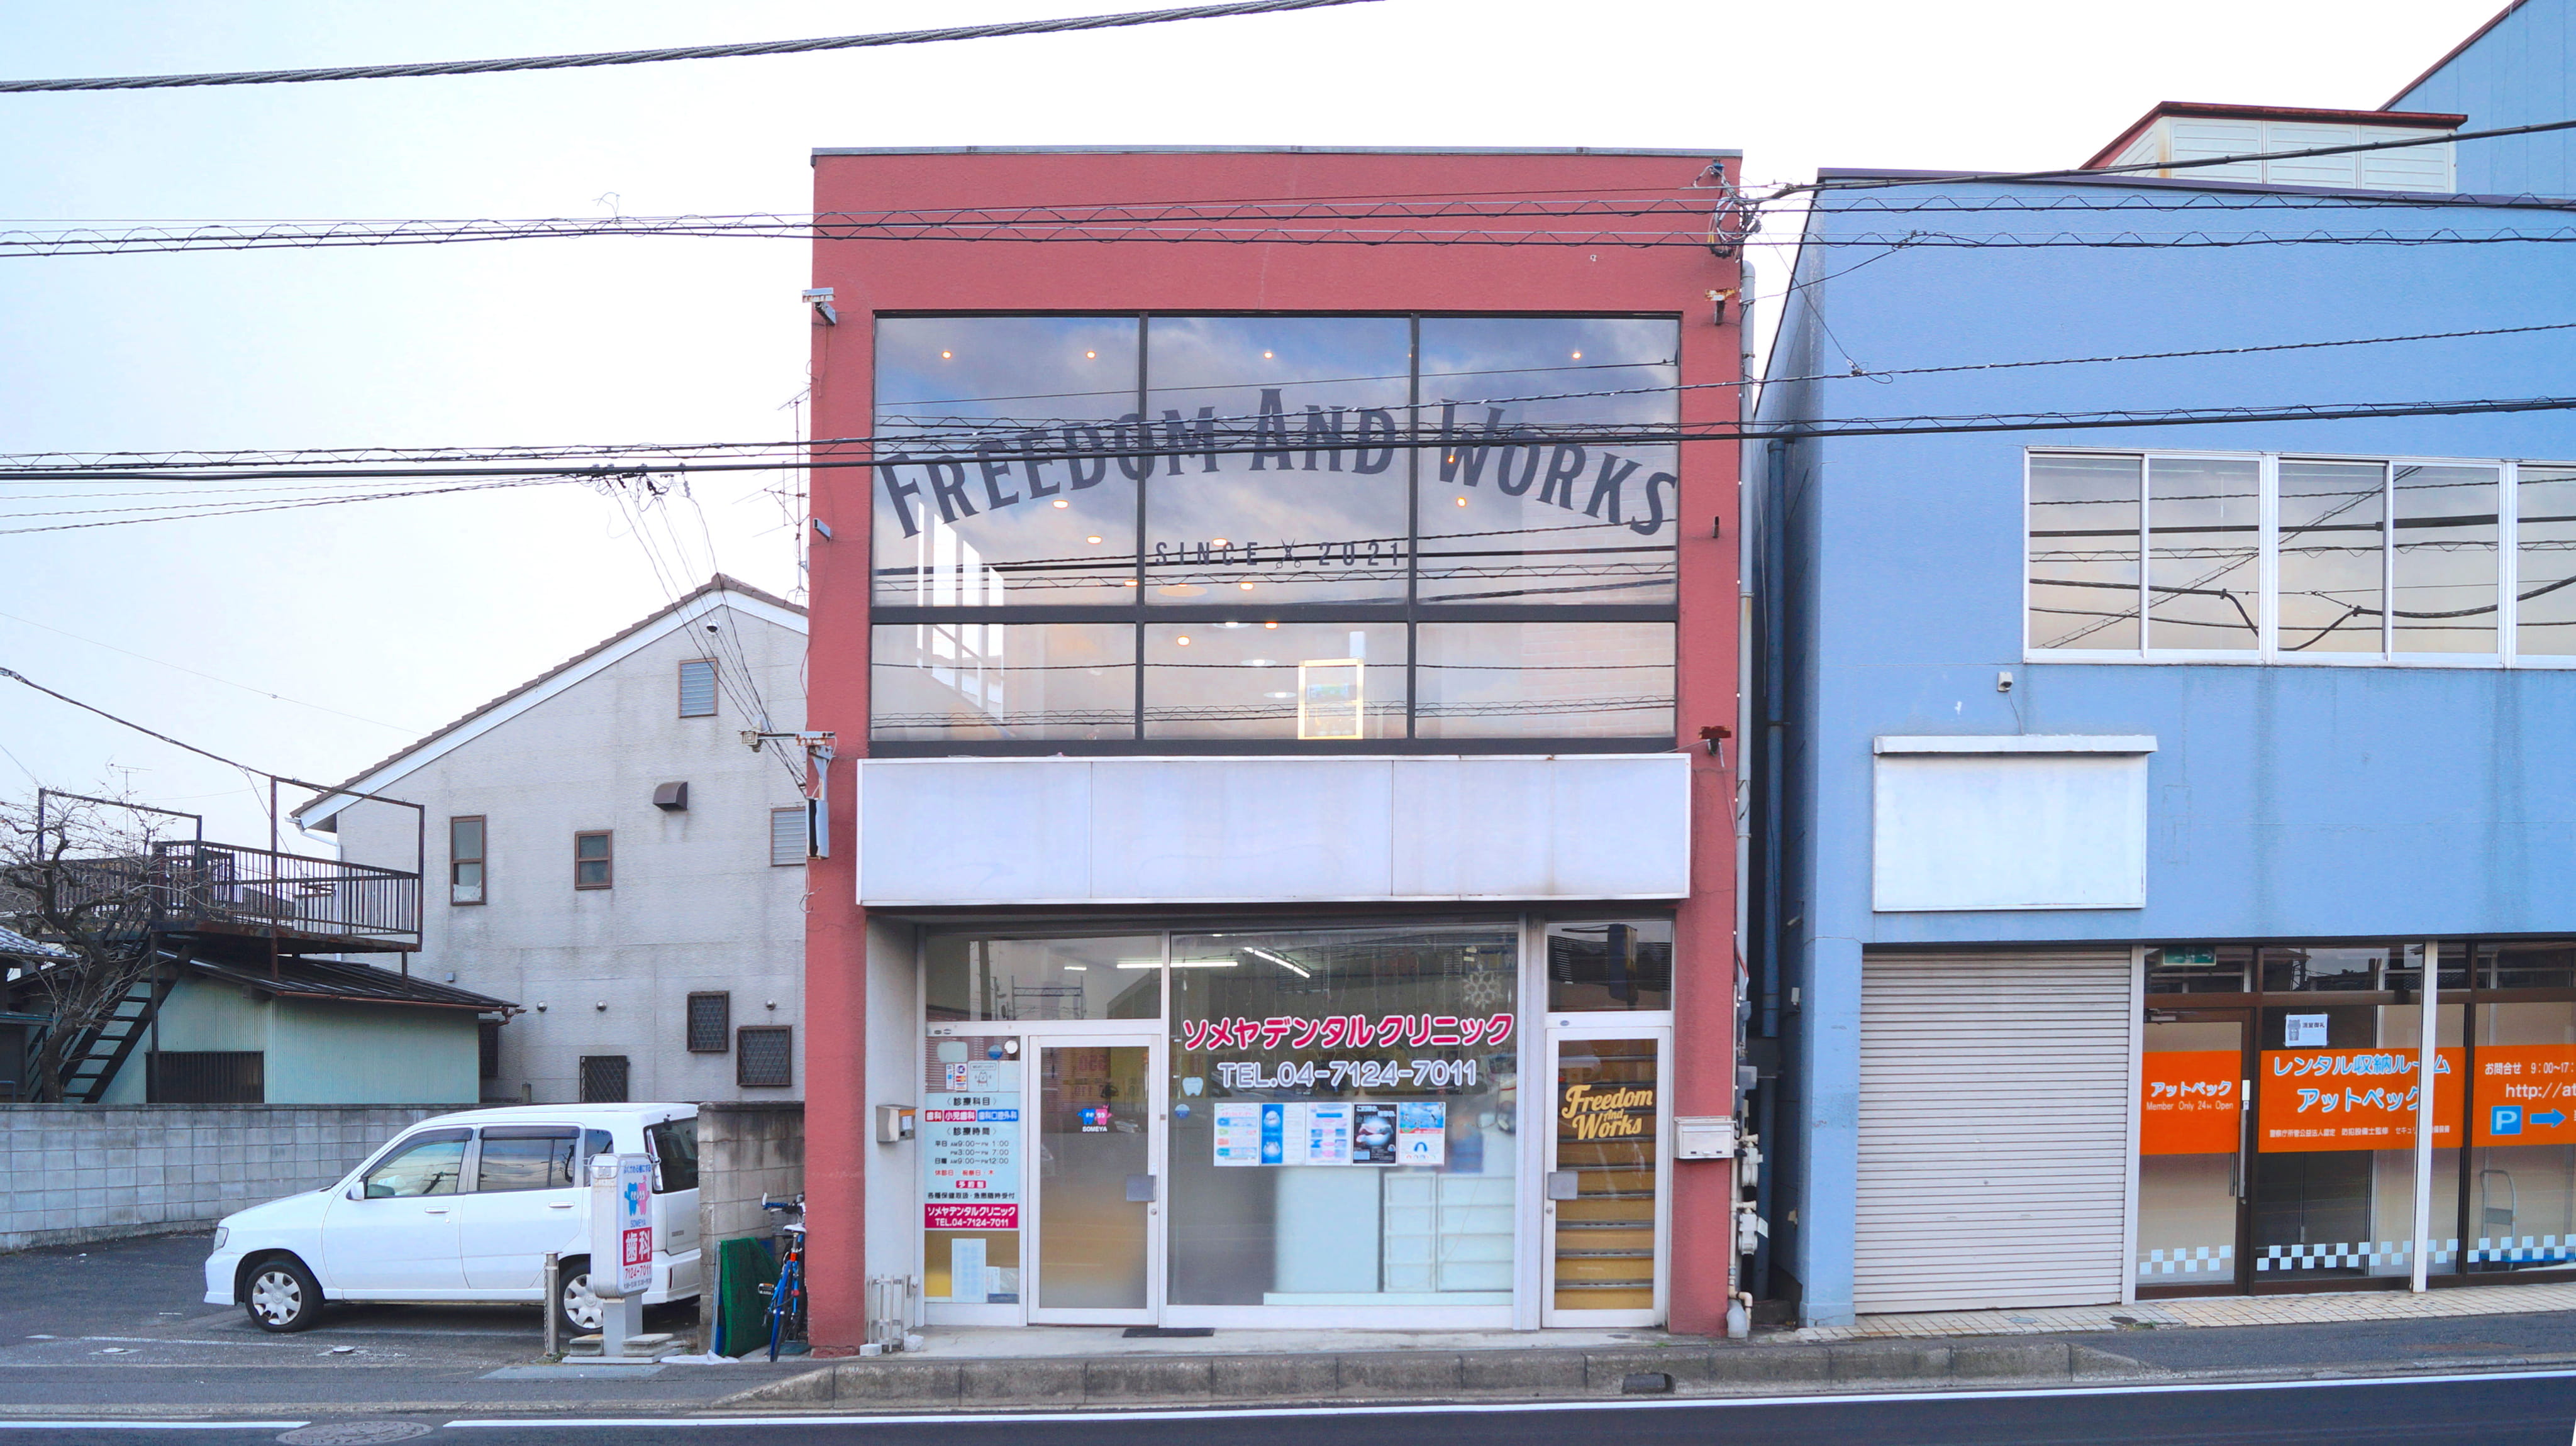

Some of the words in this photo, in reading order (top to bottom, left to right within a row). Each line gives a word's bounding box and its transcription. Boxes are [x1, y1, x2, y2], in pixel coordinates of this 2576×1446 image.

[1439, 399, 1677, 536] WORKS
[1156, 541, 1258, 565] SINCE
[1318, 541, 1399, 566] 2021
[1183, 1013, 1514, 1051] ソメヤデンタルクリニック
[1217, 1059, 1477, 1089] TEL.04-7124-7011
[2485, 1062, 2522, 1075] お問合せ
[2151, 1081, 2232, 1097] アットペック
[1561, 1084, 1653, 1118] Freedom
[2146, 1101, 2174, 1110] Member
[2179, 1101, 2194, 1112] Only
[2215, 1100, 2233, 1111] Open
[945, 1111, 975, 1120] 小児歯科
[2496, 1110, 2518, 1130] P
[1572, 1113, 1642, 1140] Works
[928, 1206, 1016, 1217] ソメヤデンタルクリニック
[935, 1218, 1008, 1227] TEL.04-7124-7011
[625, 1230, 650, 1262] 歯科
[625, 1264, 652, 1279] 7124-7011
